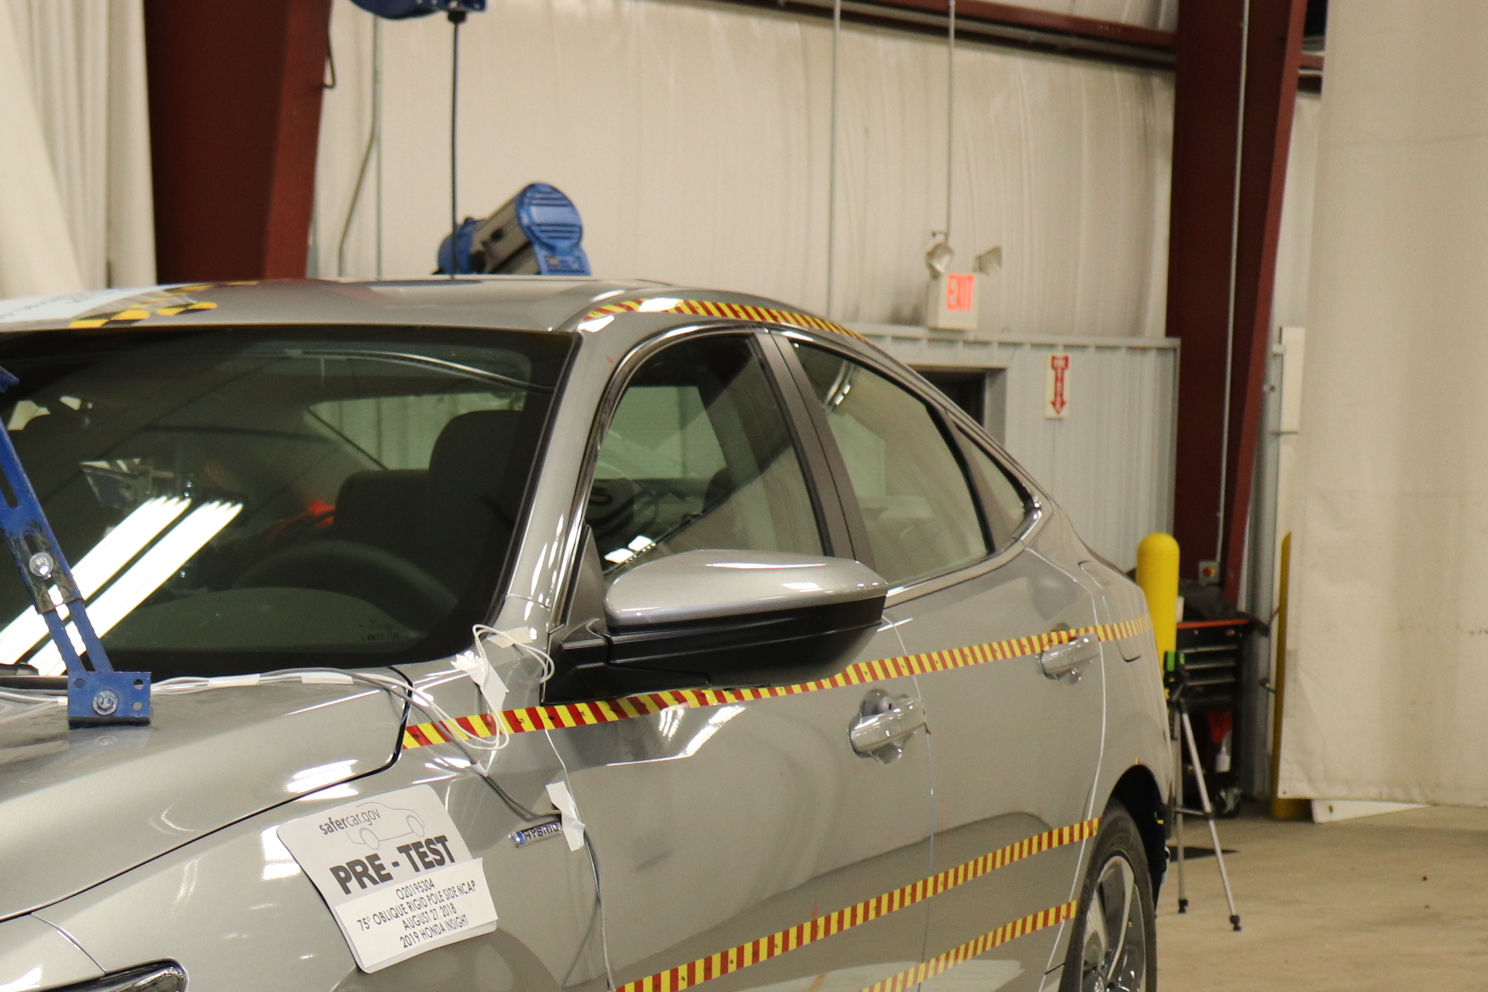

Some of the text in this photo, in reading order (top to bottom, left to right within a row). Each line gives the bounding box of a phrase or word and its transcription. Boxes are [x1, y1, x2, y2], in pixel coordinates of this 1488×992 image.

[947, 274, 975, 311] EXIT
[319, 808, 381, 835] safercar.gov
[524, 821, 560, 841] HYBRID
[329, 853, 394, 895] PRE
[396, 834, 456, 873] TEST
[372, 903, 408, 925] OBLIQUE
[406, 896, 428, 912] RIGID
[426, 890, 444, 908] POLE
[442, 887, 459, 901] SIDE
[456, 880, 476, 897] NCAP
[402, 910, 431, 931] AUGUST
[439, 902, 457, 918] 2018
[400, 914, 469, 949] 2019 HONDA INSIGHT
